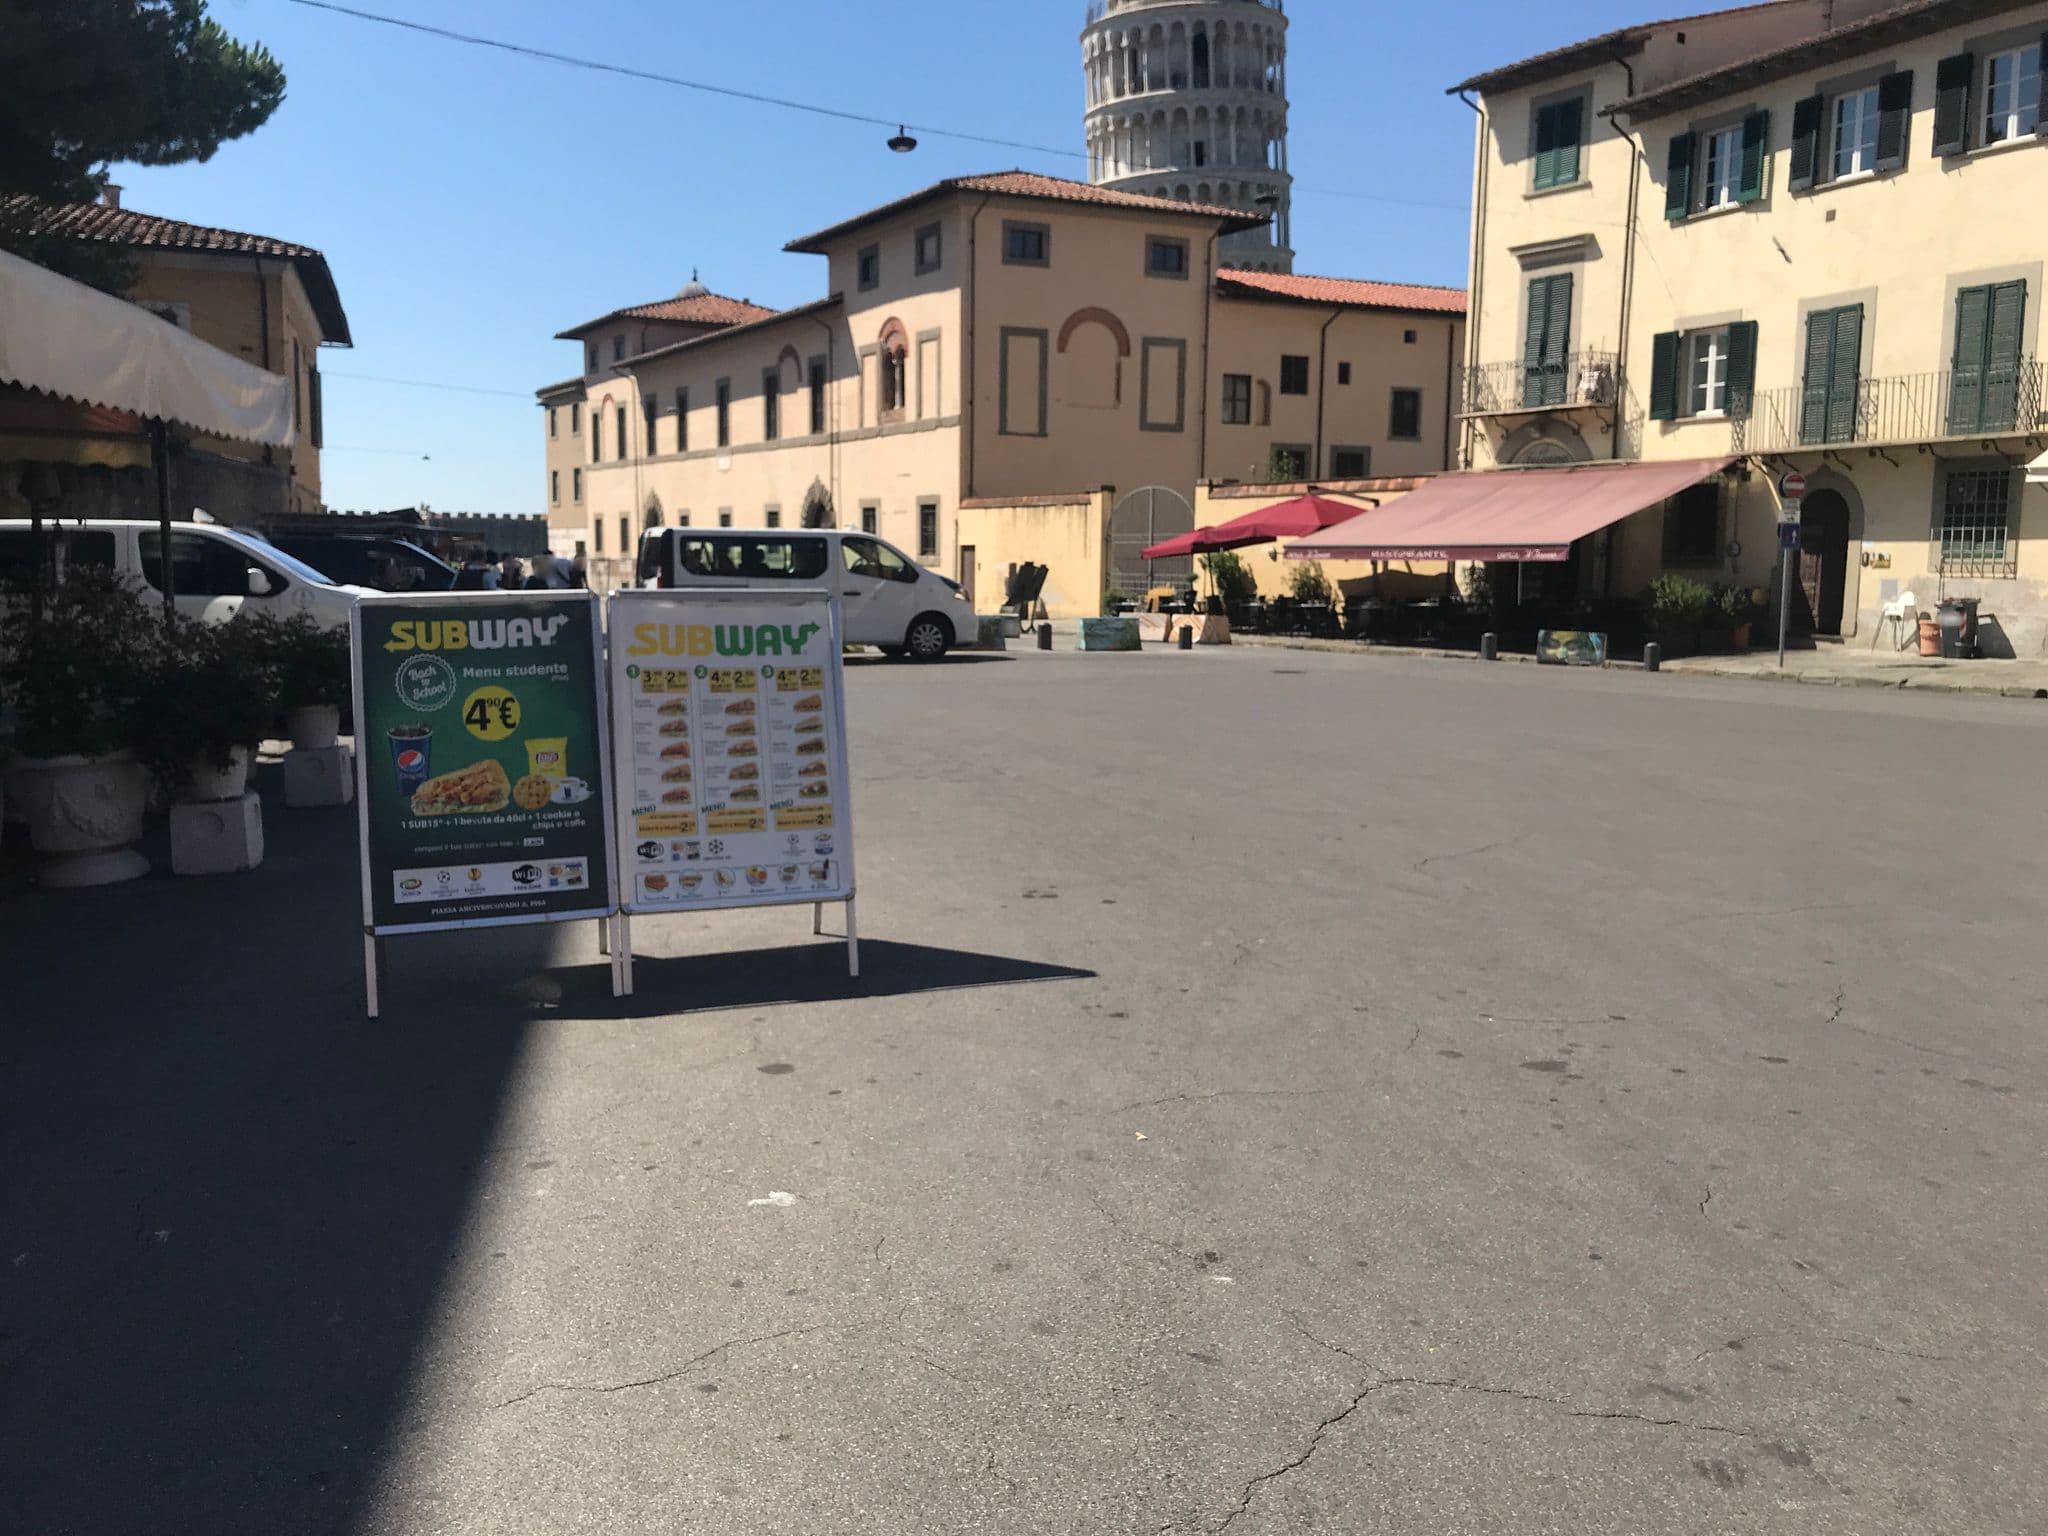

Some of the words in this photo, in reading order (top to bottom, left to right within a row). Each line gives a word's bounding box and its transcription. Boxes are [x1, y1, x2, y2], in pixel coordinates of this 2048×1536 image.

[384, 613, 569, 652] SUBWAY
[626, 622, 821, 656] SUBWAY
[463, 667, 501, 678] Menu
[506, 663, 568, 676] studente
[413, 682, 447, 700] School
